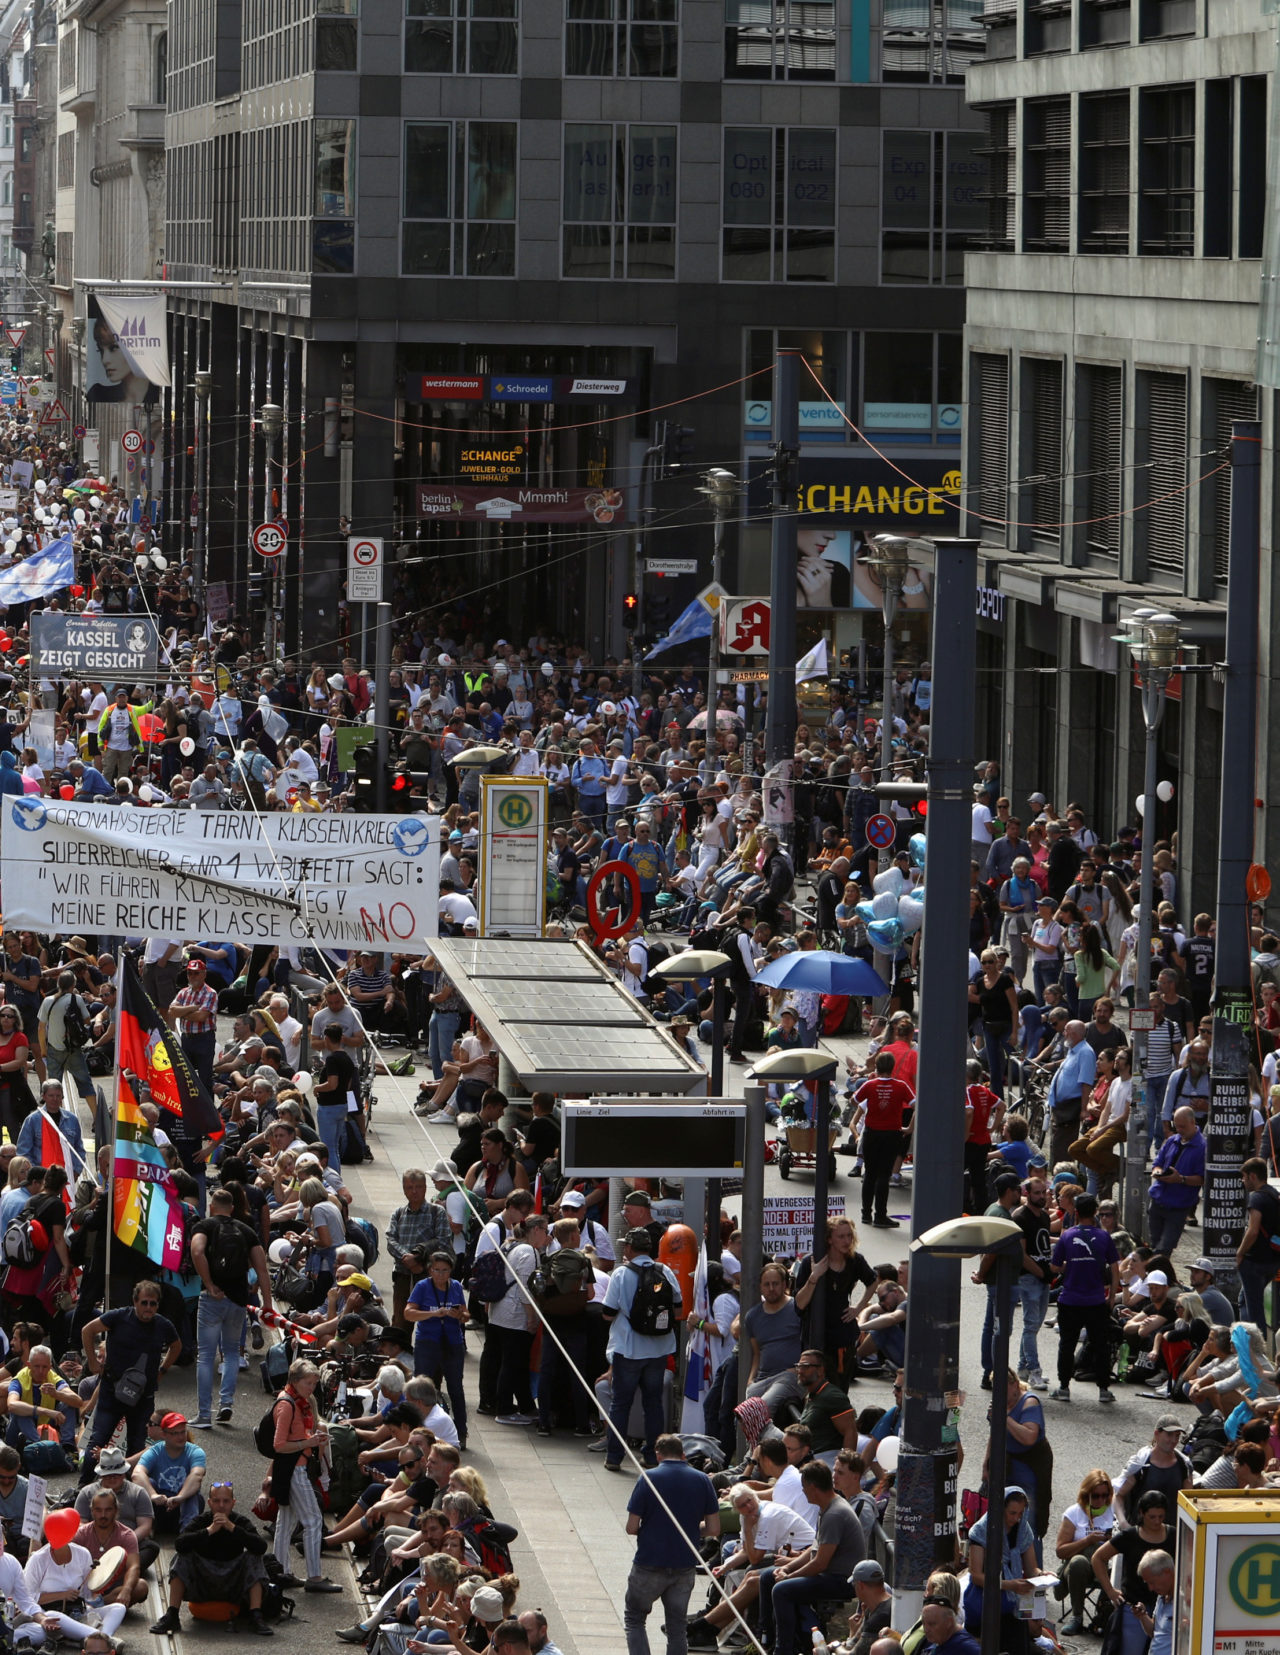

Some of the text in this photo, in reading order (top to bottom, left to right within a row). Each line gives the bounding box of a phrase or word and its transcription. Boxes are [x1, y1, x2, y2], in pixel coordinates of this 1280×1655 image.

[426, 379, 479, 388] westermann
[506, 384, 549, 394] Schroedel
[575, 382, 621, 392] Diesterweg
[126, 436, 139, 447] 30
[460, 465, 521, 474] JUWELIER GOLD
[471, 474, 509, 482] LEIHHAUS
[422, 492, 451, 504] berlin
[519, 490, 569, 504] Mmmh!
[422, 504, 451, 514] tapas
[260, 532, 280, 548] 30
[649, 561, 695, 570] Dorotheenstraße
[67, 631, 120, 648] KASSEL
[40, 650, 147, 669] ZEIGT GESICHT
[730, 671, 769, 682] PHARMACY
[200, 814, 268, 842] TARNT
[277, 817, 398, 845] KLASSENKRIEG
[43, 840, 170, 871] SUPERREICHER
[100, 871, 160, 899] FÜHREN
[51, 901, 106, 926] MEINE
[116, 903, 187, 931] REICHE
[198, 906, 281, 937] KLASSE
[1195, 954, 1208, 975] 2
[1215, 1084, 1246, 1095] RUHIG
[1212, 1096, 1248, 1107] BLEIBEN
[576, 1108, 736, 1116] Linie Ziel Abfahrt in
[1214, 1114, 1246, 1125] DILDOS
[1208, 1124, 1248, 1136] BENUTZEN
[136, 1163, 170, 1185] PAIX
[1213, 1178, 1243, 1189] RUHIG
[1209, 1189, 1245, 1200] BLEIBEN
[827, 1196, 846, 1206] OHIN
[1211, 1207, 1243, 1218] DILDOS
[776, 1228, 790, 1237] MAL
[1223, 1640, 1265, 1651] M1 Mitte
